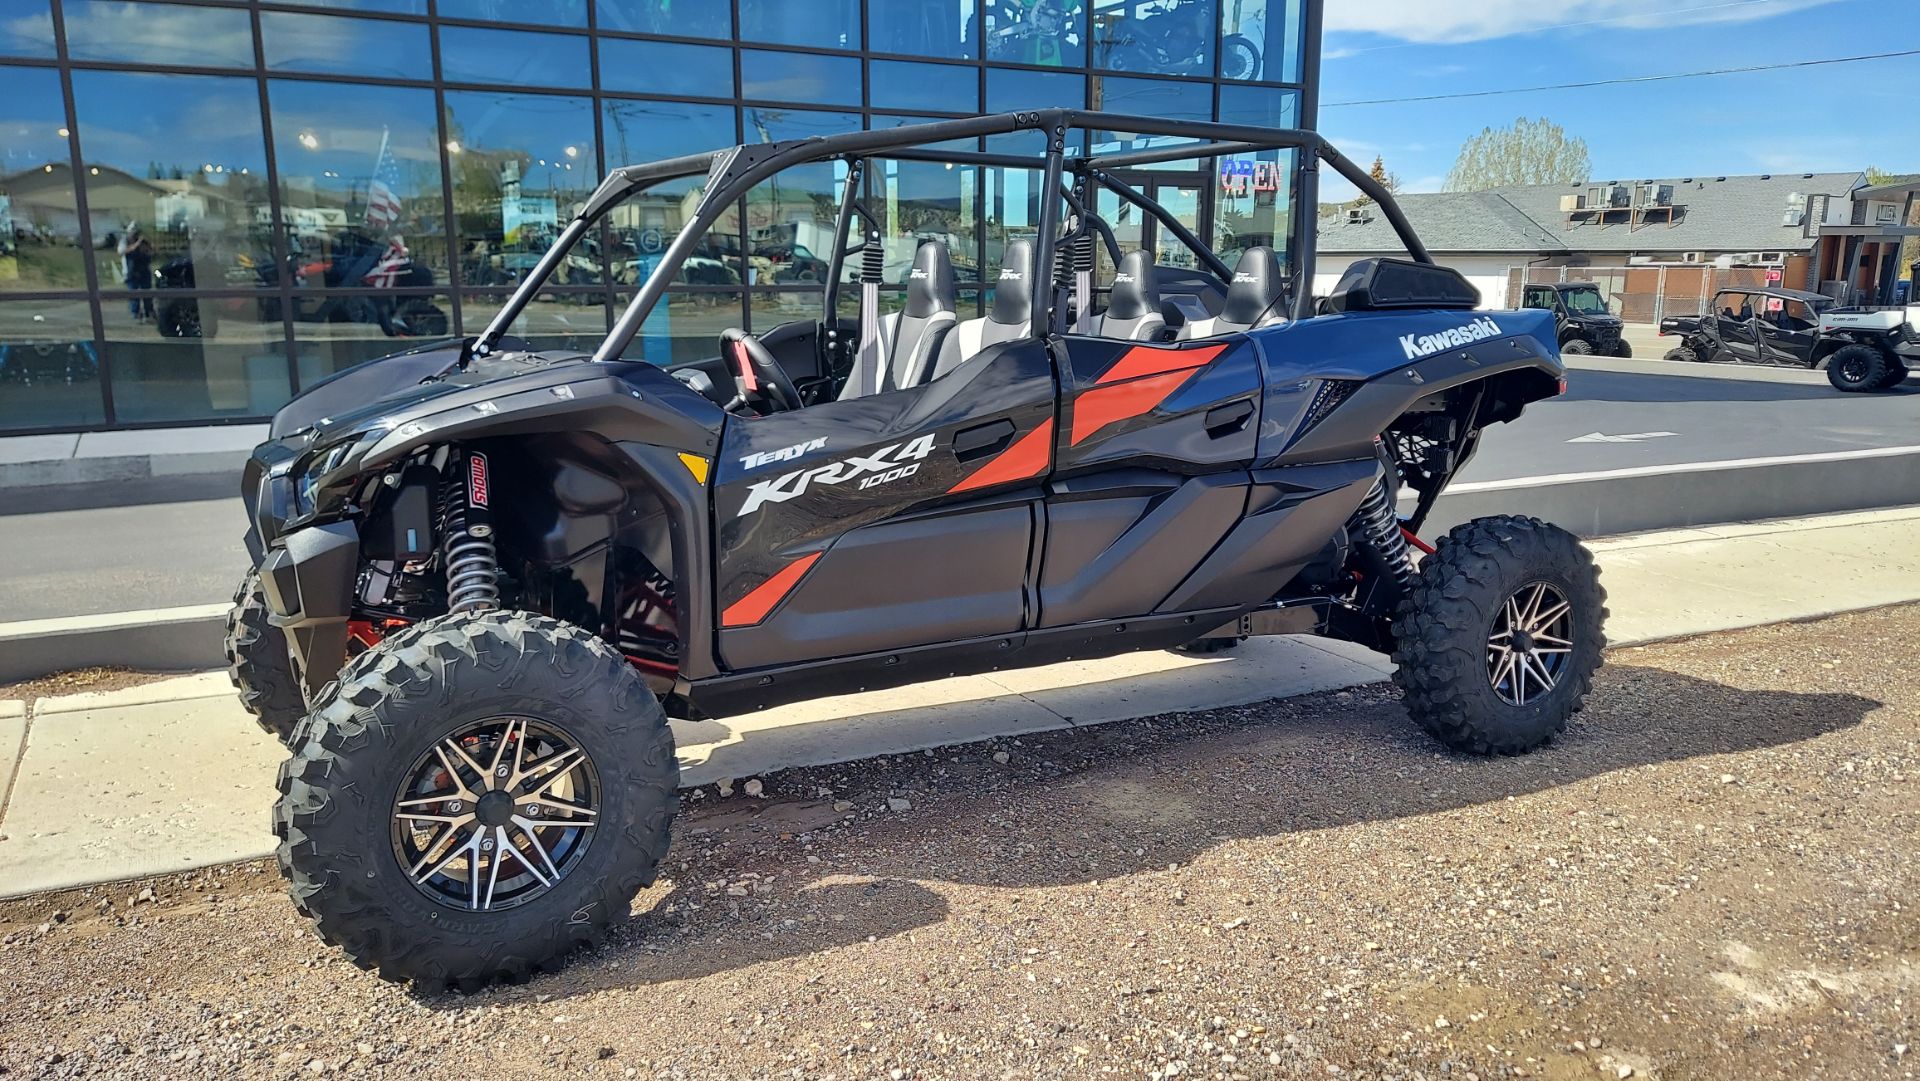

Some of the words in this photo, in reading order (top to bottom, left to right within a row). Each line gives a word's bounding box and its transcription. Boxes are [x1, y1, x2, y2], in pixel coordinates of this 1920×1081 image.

[1221, 160, 1282, 191] OPEN
[1399, 316, 1502, 360] Kawasaki
[471, 456, 488, 506] SHOWA
[858, 462, 921, 490] 1000
